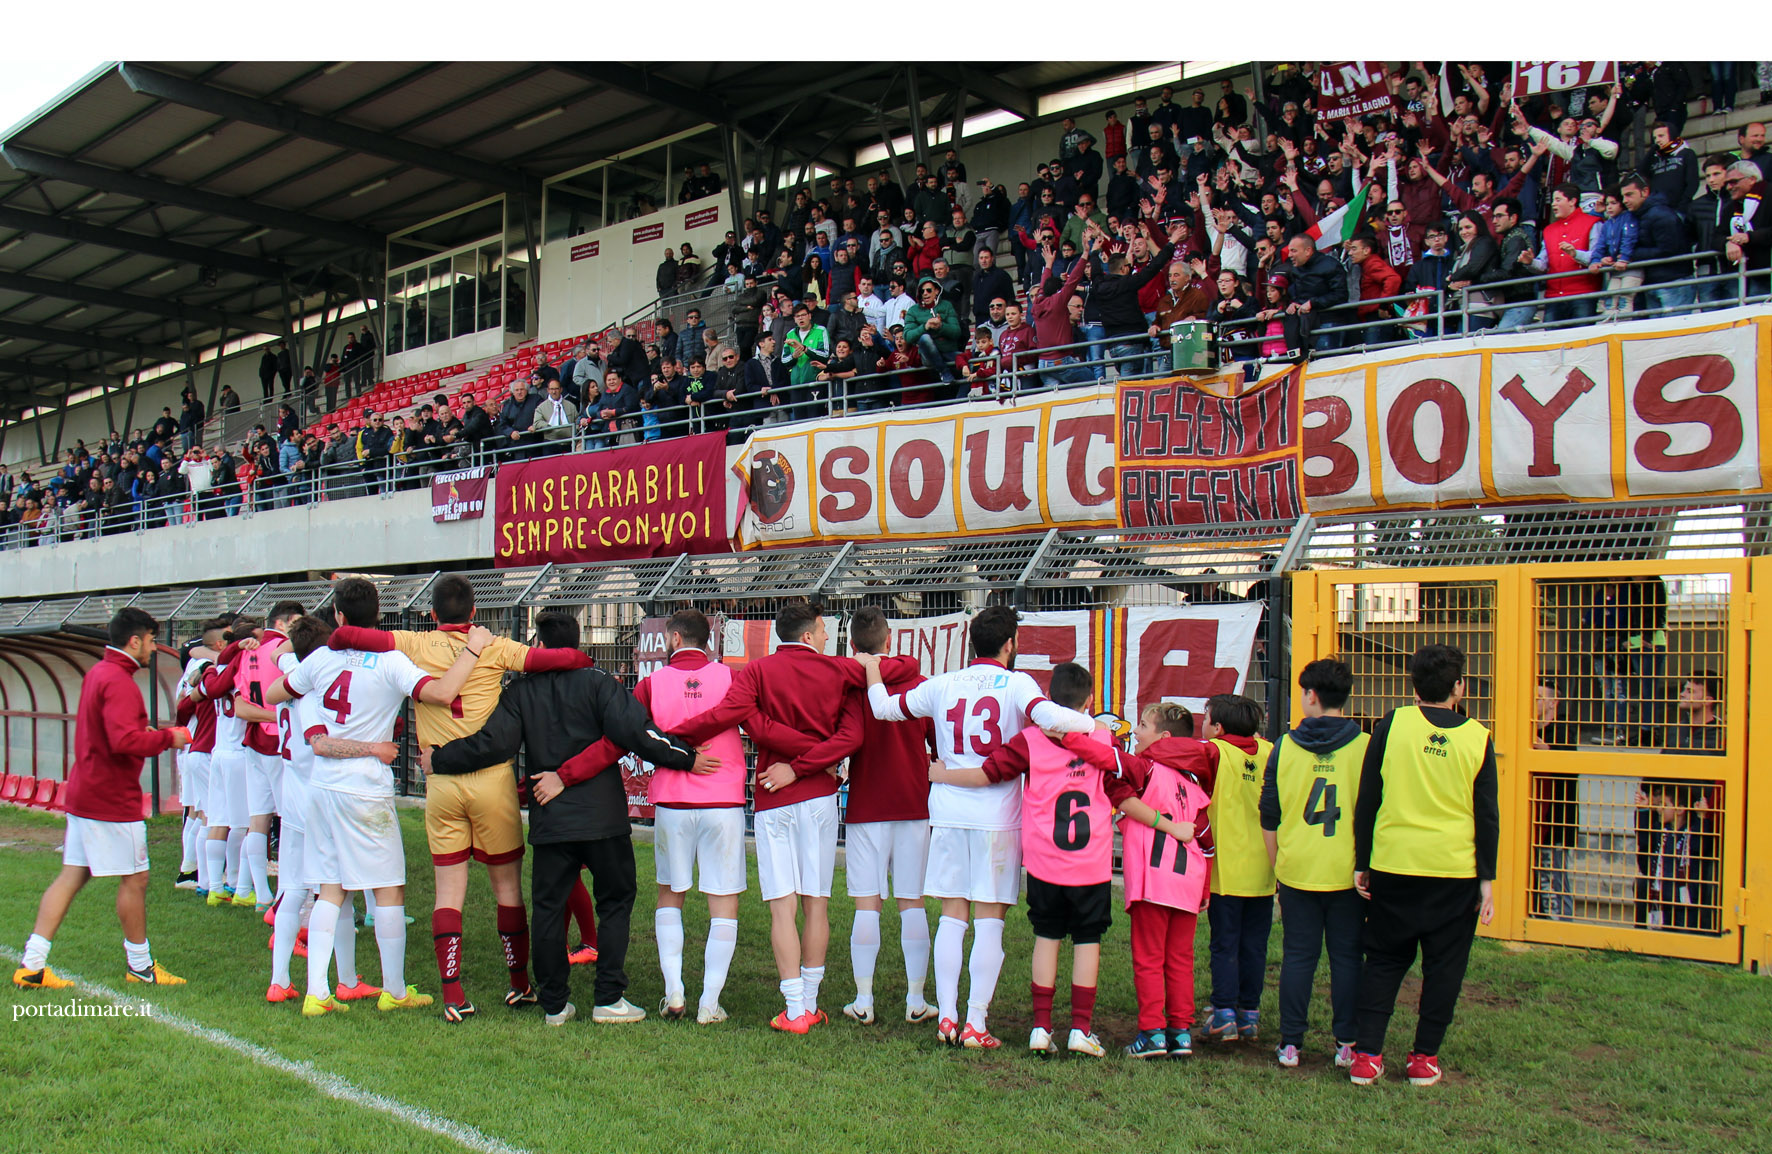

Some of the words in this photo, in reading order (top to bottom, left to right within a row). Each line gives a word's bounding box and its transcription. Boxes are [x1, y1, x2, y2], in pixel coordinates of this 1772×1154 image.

[1327, 107, 1351, 119] MARIA
[1352, 104, 1362, 115] AL
[1362, 95, 1390, 111] BAGNO
[1520, 61, 1609, 95] 167
[1122, 374, 1290, 457] ASSENTI
[512, 460, 704, 515] INSEPARABILI
[820, 414, 1116, 523] SOUT
[1122, 458, 1300, 530] PRESENTI
[323, 670, 353, 725] 4
[946, 695, 1003, 757] 13
[1423, 744, 1447, 757] errea
[1053, 790, 1091, 851] 6
[1303, 777, 1341, 837] 4
